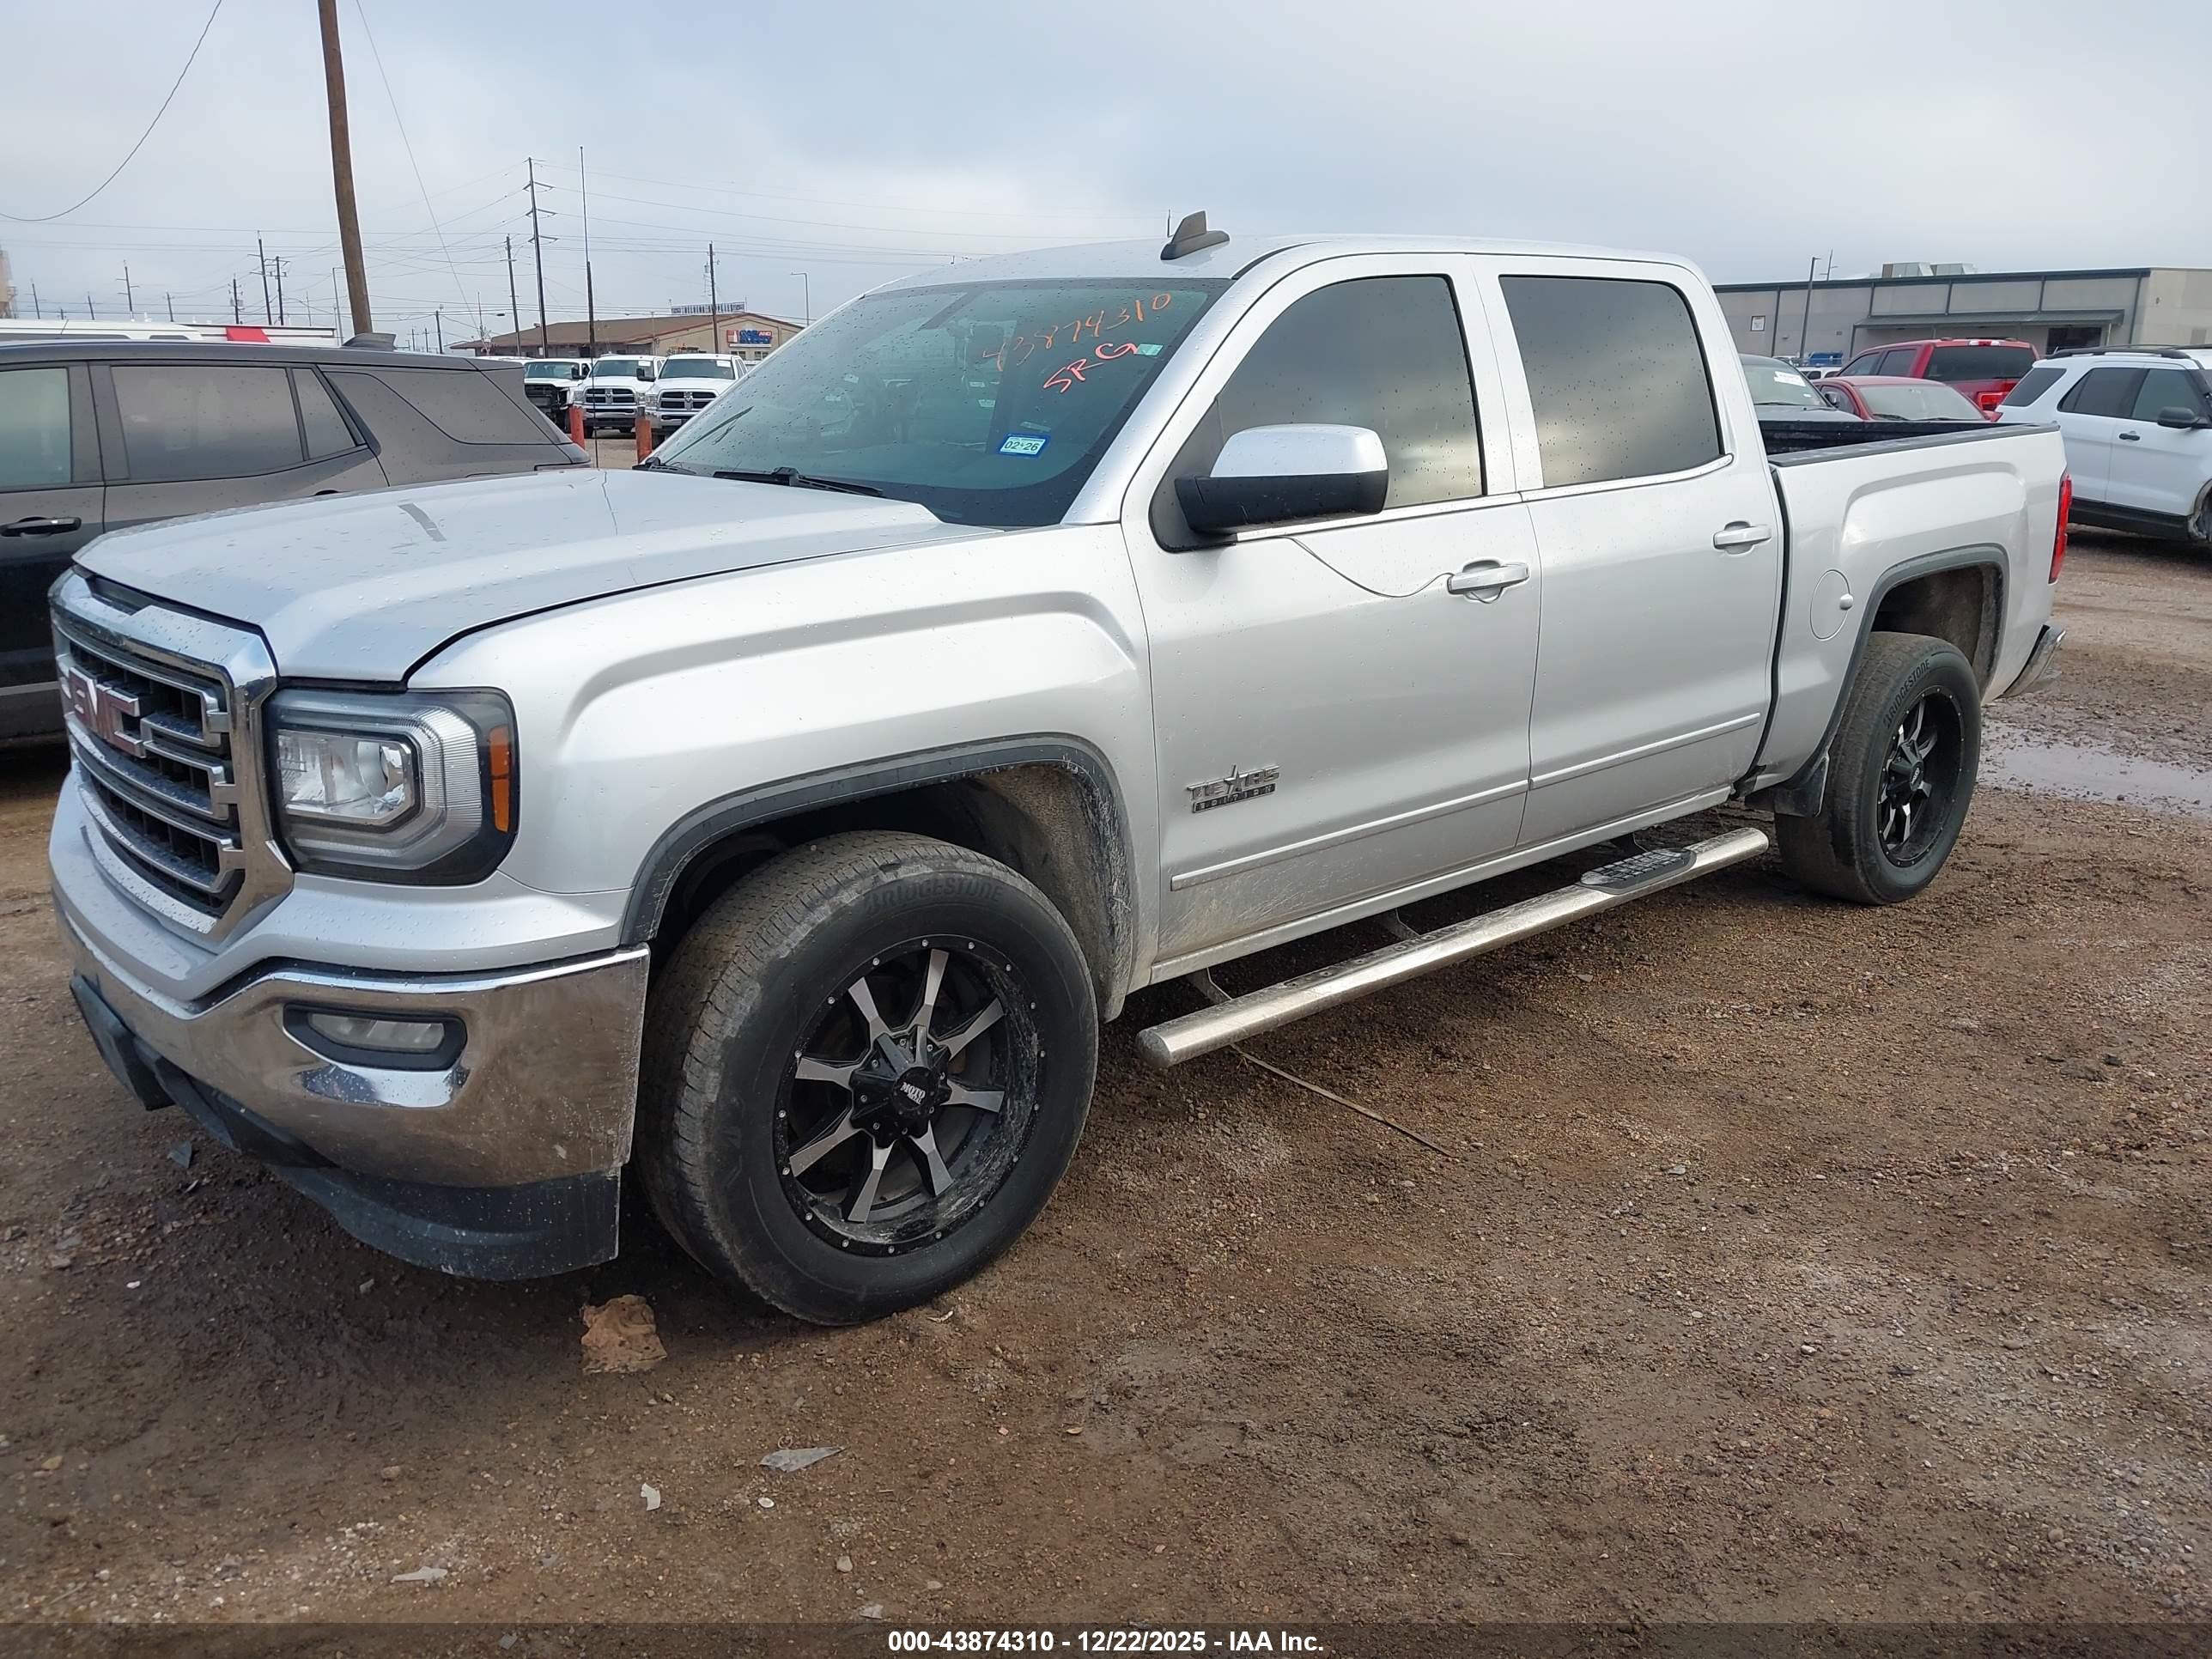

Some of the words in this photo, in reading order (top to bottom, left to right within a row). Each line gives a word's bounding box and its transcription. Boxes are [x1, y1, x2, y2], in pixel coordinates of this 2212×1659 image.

[981, 292, 1172, 373] 43874310
[862, 876, 1004, 915] BRIDGESTONE
[899, 1081, 927, 1099] MOTO
